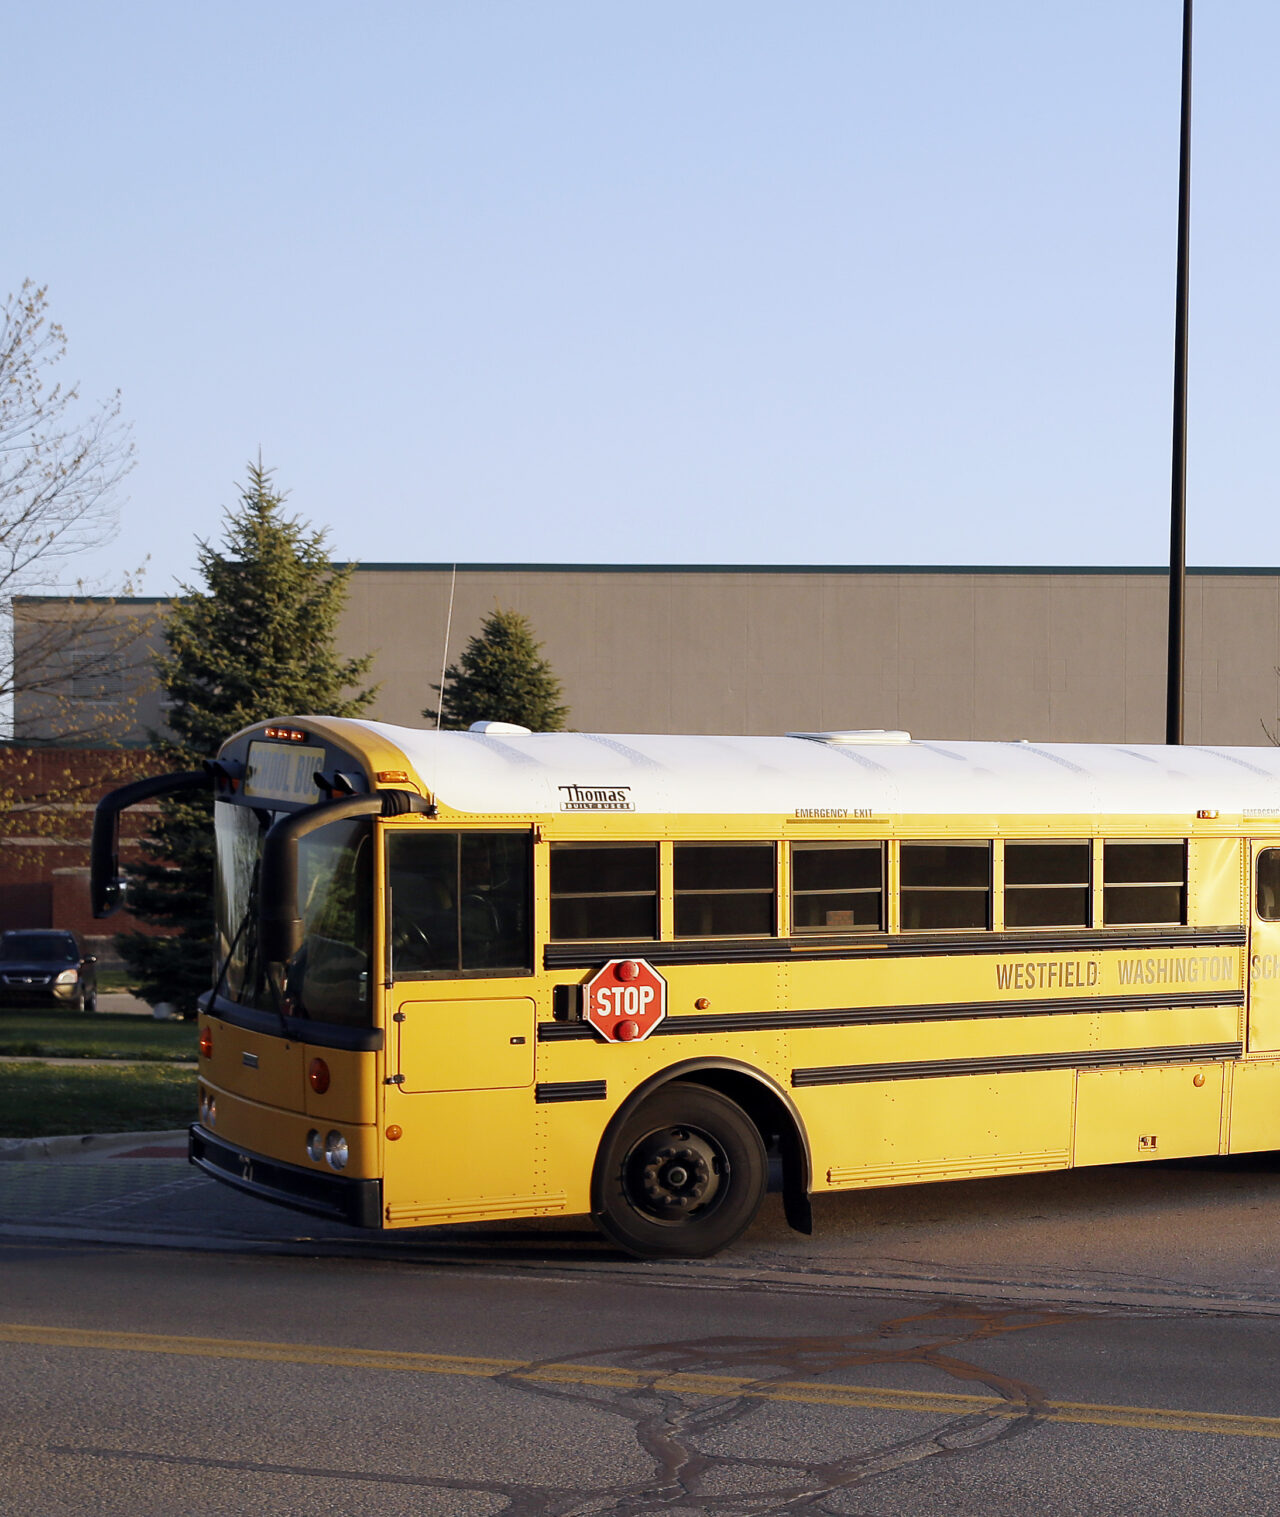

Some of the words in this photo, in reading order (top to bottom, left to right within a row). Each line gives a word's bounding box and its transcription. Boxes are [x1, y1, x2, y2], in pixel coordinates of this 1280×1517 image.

[558, 784, 631, 802] Thomas
[795, 808, 848, 818] EMERGENCY
[854, 808, 873, 818] EXIT
[996, 961, 1098, 990] WESTFIELD
[1118, 956, 1233, 985] WASHINGTON
[596, 985, 655, 1017] STOP
